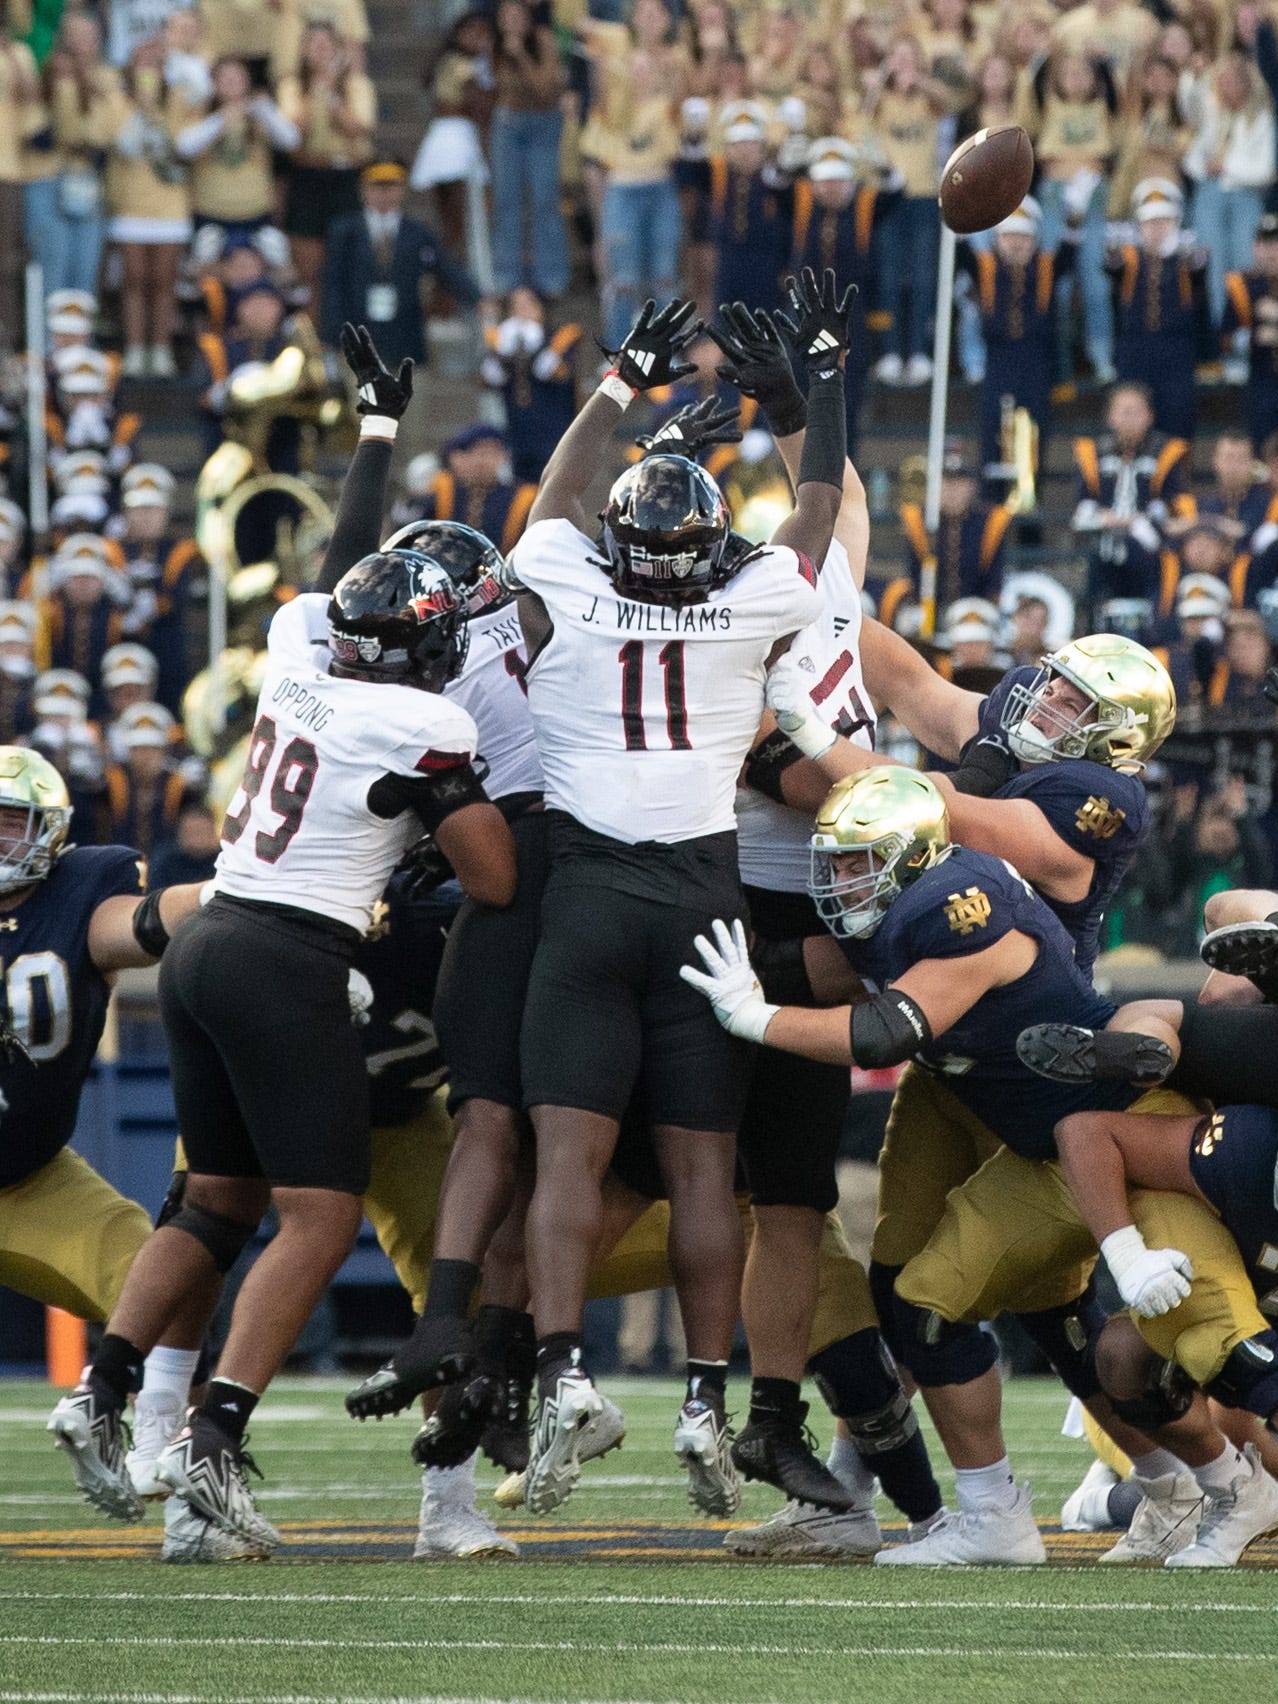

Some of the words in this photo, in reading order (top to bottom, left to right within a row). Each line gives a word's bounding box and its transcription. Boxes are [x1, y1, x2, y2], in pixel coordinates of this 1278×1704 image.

[654, 560, 672, 579] 11
[582, 597, 600, 625] J.
[616, 601, 733, 633] WILLIAMS
[272, 677, 335, 732] OPPONG
[618, 640, 694, 751] 11
[220, 713, 320, 864] 99
[0, 950, 73, 1062] 0
